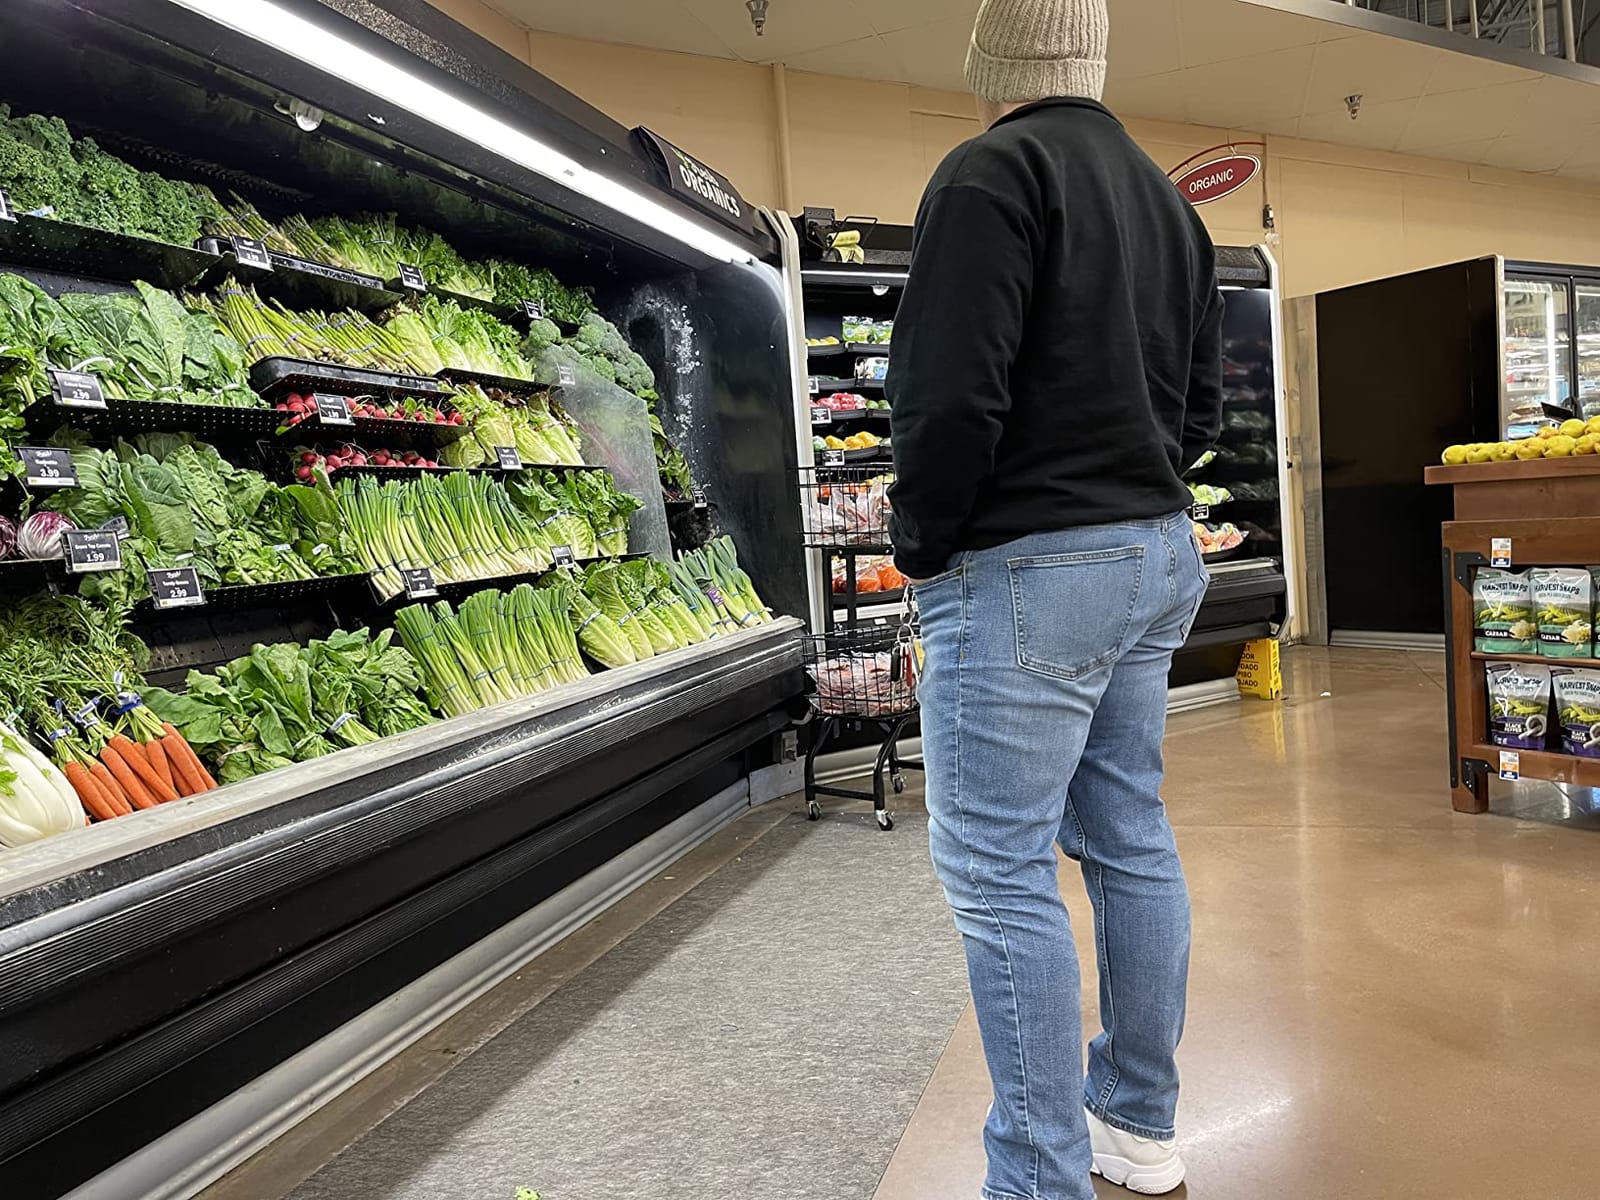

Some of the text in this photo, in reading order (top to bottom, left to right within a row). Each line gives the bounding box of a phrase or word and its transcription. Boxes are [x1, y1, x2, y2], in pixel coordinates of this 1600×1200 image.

[1189, 168, 1234, 193] ORGANIC
[679, 164, 740, 218] ORGANICS
[39, 468, 60, 477] 3.99
[86, 553, 104, 562] 1.99
[169, 589, 187, 598] 2.99
[1240, 663, 1259, 671] DADO
[1237, 679, 1258, 687] OJADO
[1560, 680, 1586, 690] HARVEST
